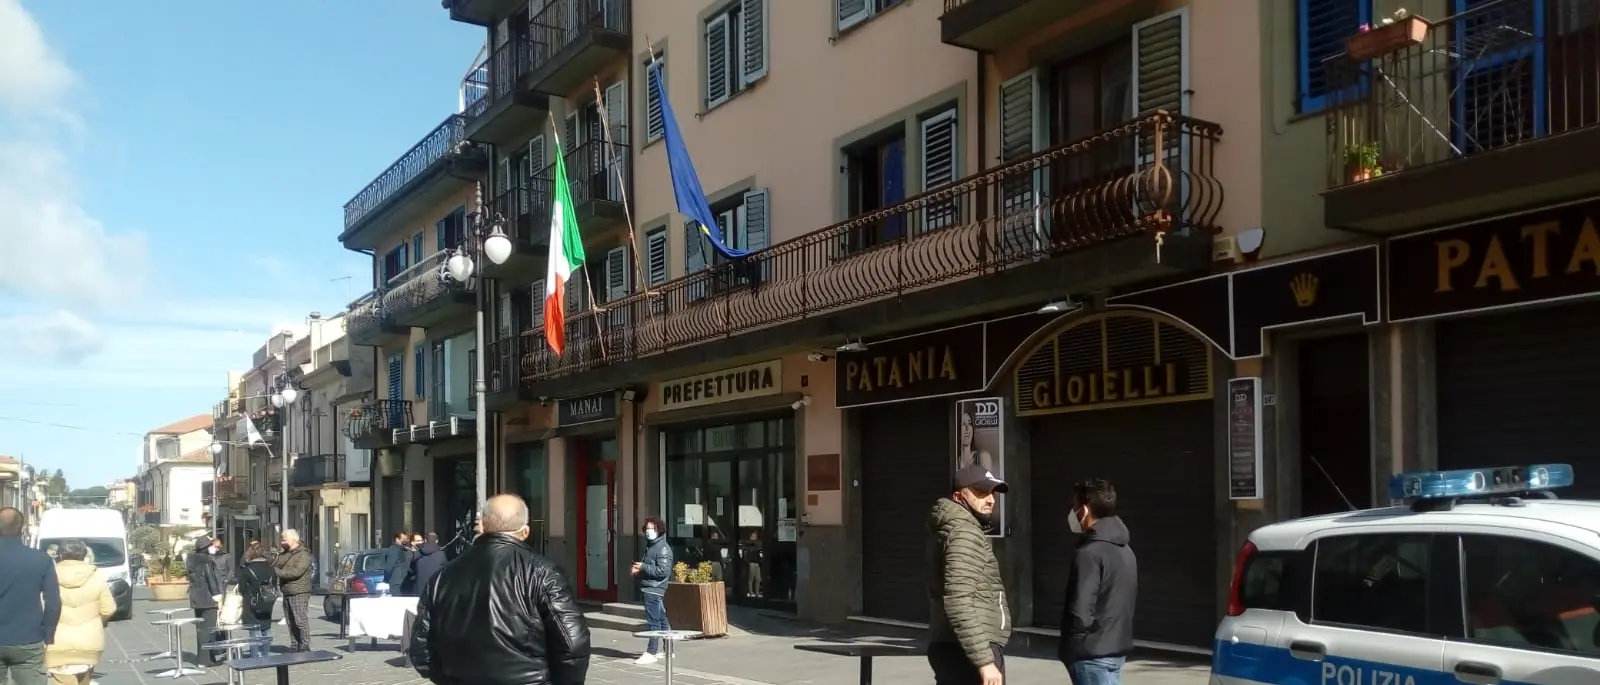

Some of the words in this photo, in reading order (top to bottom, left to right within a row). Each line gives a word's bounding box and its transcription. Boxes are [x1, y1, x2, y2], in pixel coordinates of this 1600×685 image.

[1434, 216, 1600, 293] PATA
[663, 366, 774, 405] PREFETTURA
[846, 345, 957, 392] PATANIA
[1033, 362, 1176, 408] GIOIELLI
[569, 396, 603, 416] MANAI
